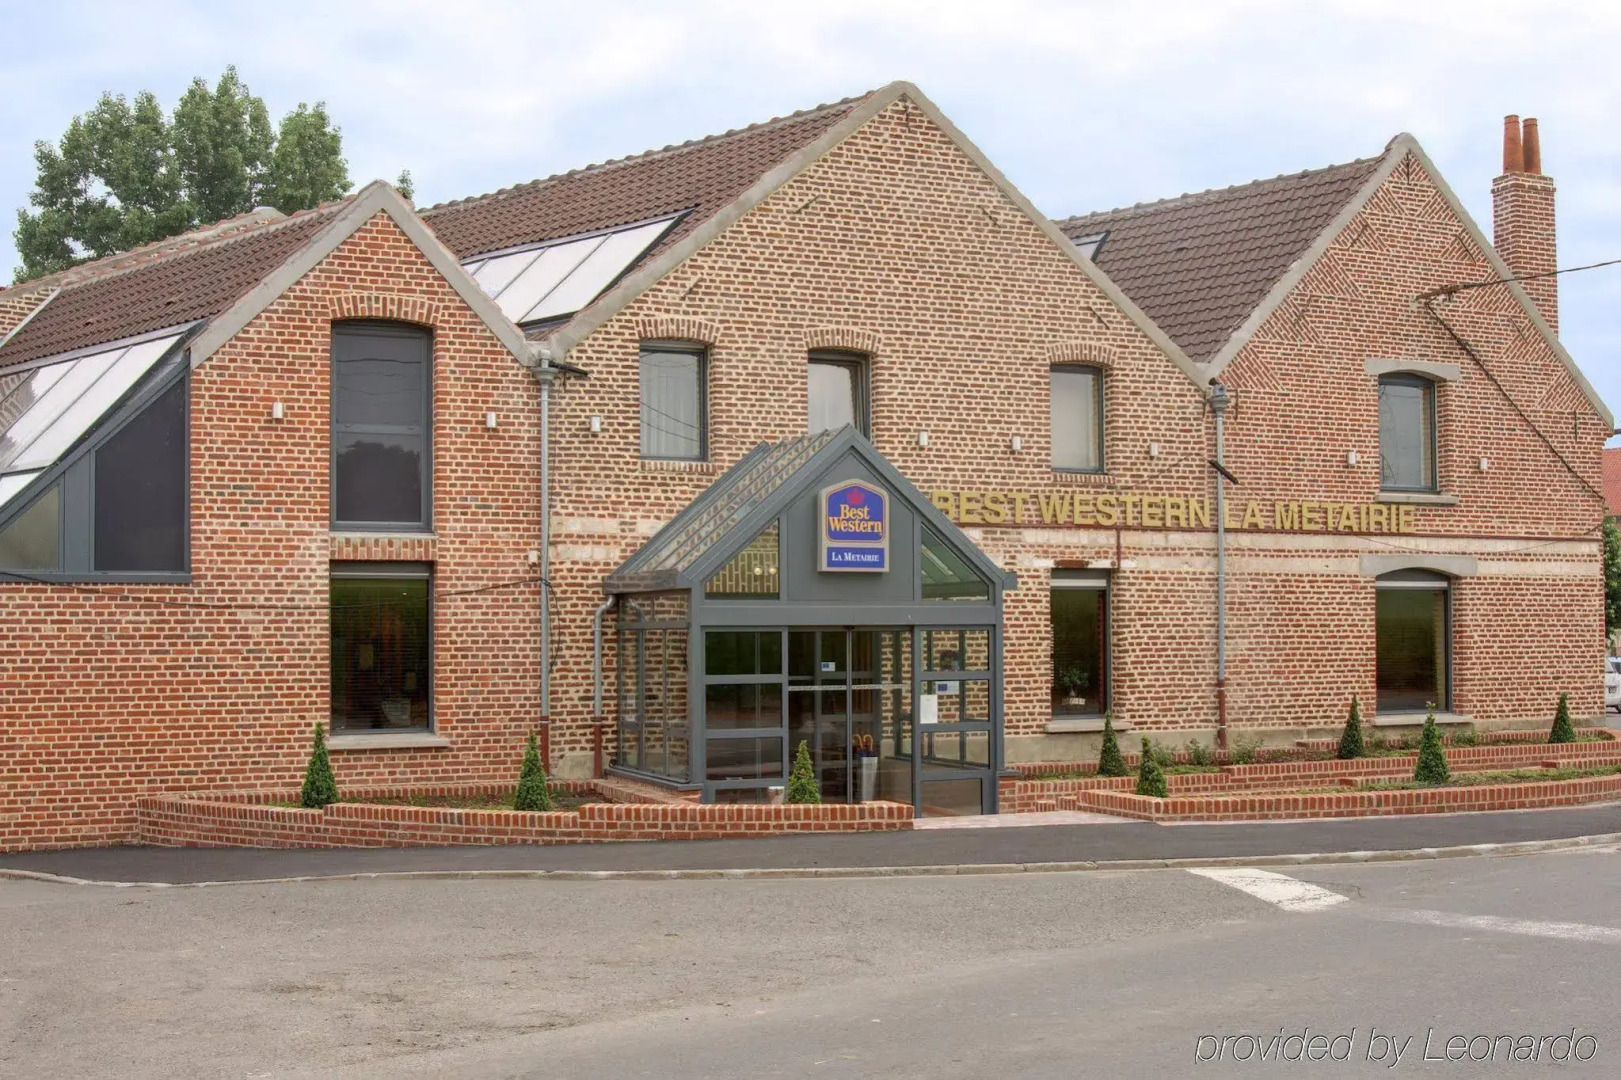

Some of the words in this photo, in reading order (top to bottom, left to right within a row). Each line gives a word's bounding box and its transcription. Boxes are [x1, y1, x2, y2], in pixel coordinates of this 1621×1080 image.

[840, 504, 870, 519] Best
[932, 491, 1028, 525] BEST
[1038, 493, 1211, 529] WESTERN
[1223, 499, 1265, 529] LA
[1275, 501, 1416, 533] METAIRIE
[829, 517, 882, 533] Western
